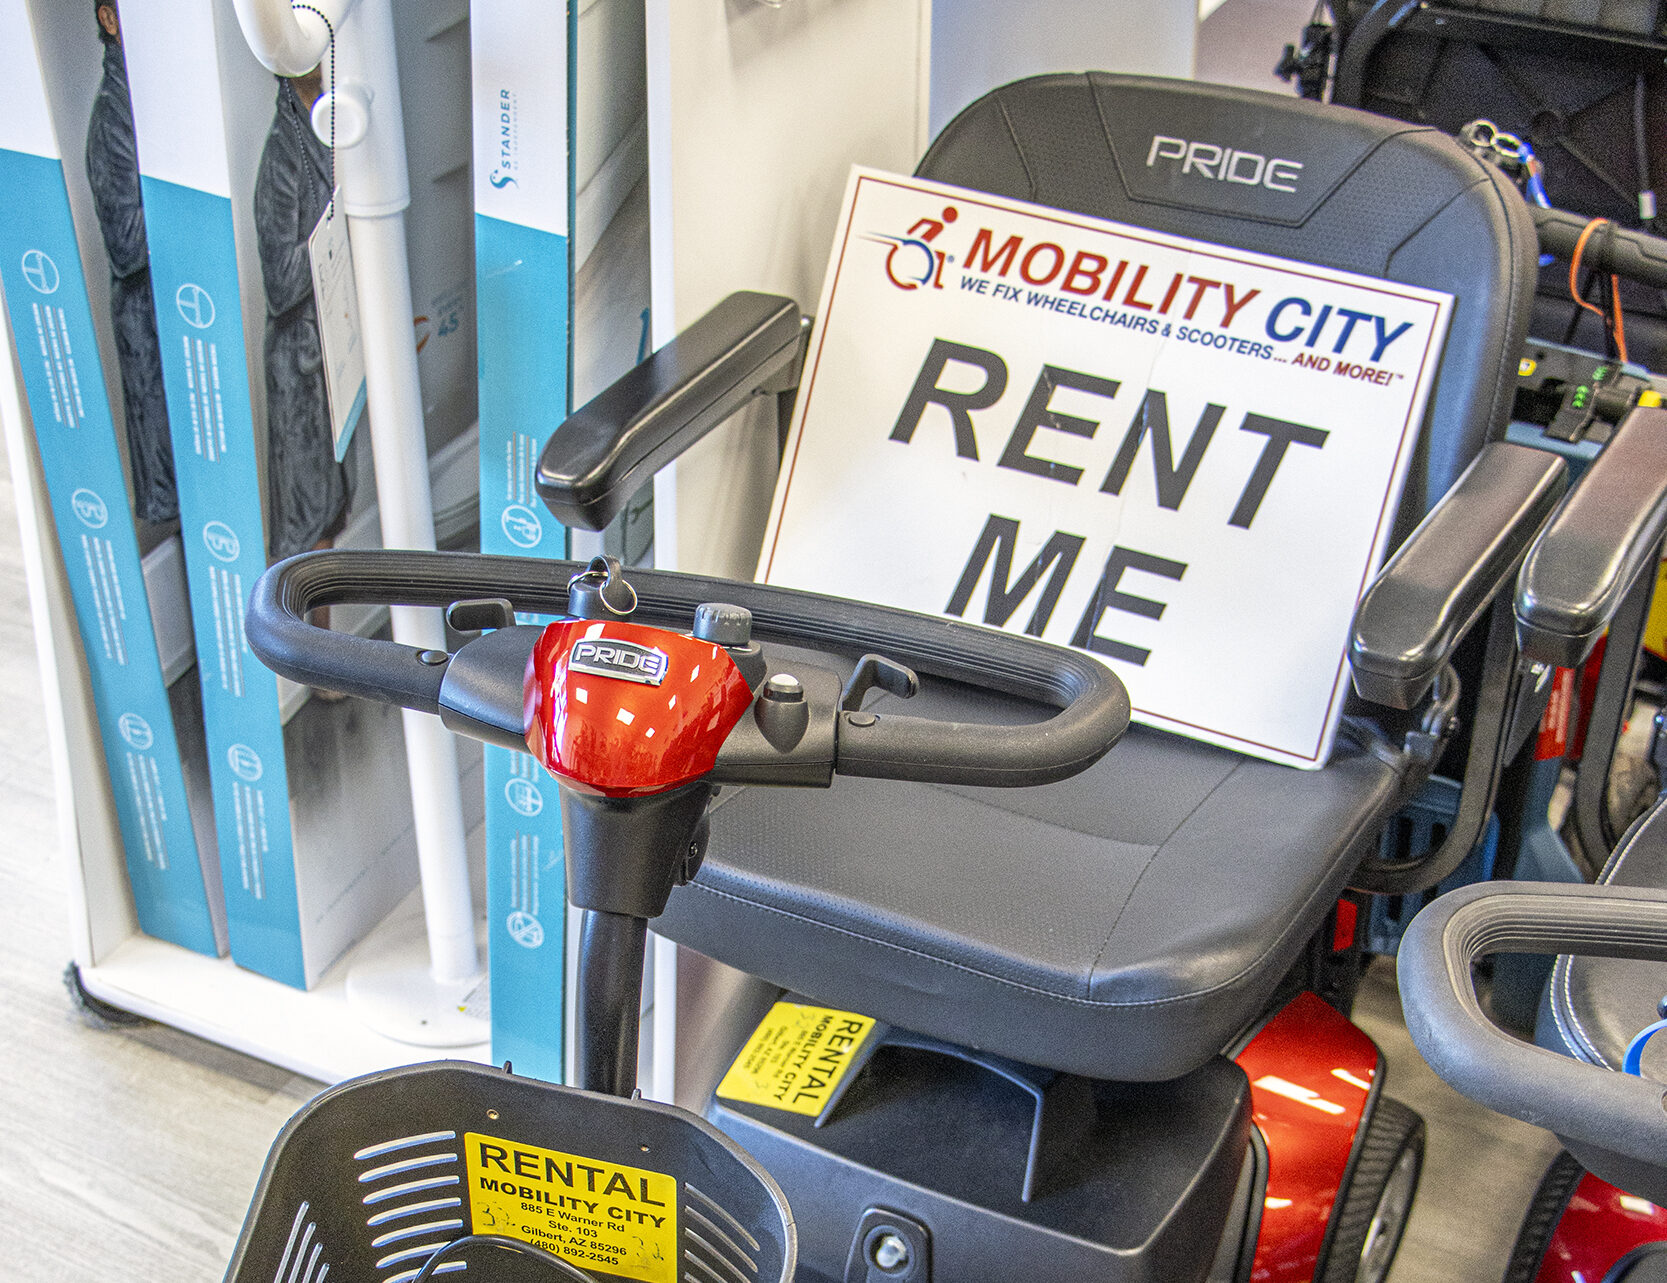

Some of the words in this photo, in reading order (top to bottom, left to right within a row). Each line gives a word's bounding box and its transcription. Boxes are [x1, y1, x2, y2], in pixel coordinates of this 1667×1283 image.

[500, 88, 511, 170] STANDER
[1146, 135, 1304, 193] PRIDE
[963, 227, 1261, 329] MOBILITY
[1265, 297, 1414, 363] CITY
[960, 275, 991, 295] WE
[992, 283, 1023, 303] FIX
[1027, 291, 1160, 335] WHEELCHAIRS
[1161, 322, 1172, 338] &
[1292, 352, 1331, 372] AND
[889, 338, 1330, 531] RENT
[944, 513, 1188, 668] ME
[575, 643, 661, 674] PRIDE
[792, 1018, 865, 1105] RENTAL
[793, 1015, 835, 1070] MOBILITY
[773, 1071, 796, 1102] CITY
[479, 1143, 666, 1208] RENTAL
[480, 1176, 599, 1214] MOBILITY
[607, 1206, 666, 1229] CITY
[520, 1202, 543, 1214] 885
[546, 1208, 555, 1217] E
[558, 1210, 604, 1228] Warner
[607, 1221, 625, 1233] Rd
[521, 1225, 567, 1244] Gilbert,
[569, 1236, 588, 1248] AZ
[590, 1241, 627, 1256] 85296
[548, 1220, 573, 1233] Ste.
[576, 1226, 598, 1238] 103
[563, 1246, 619, 1266] 892-2545
